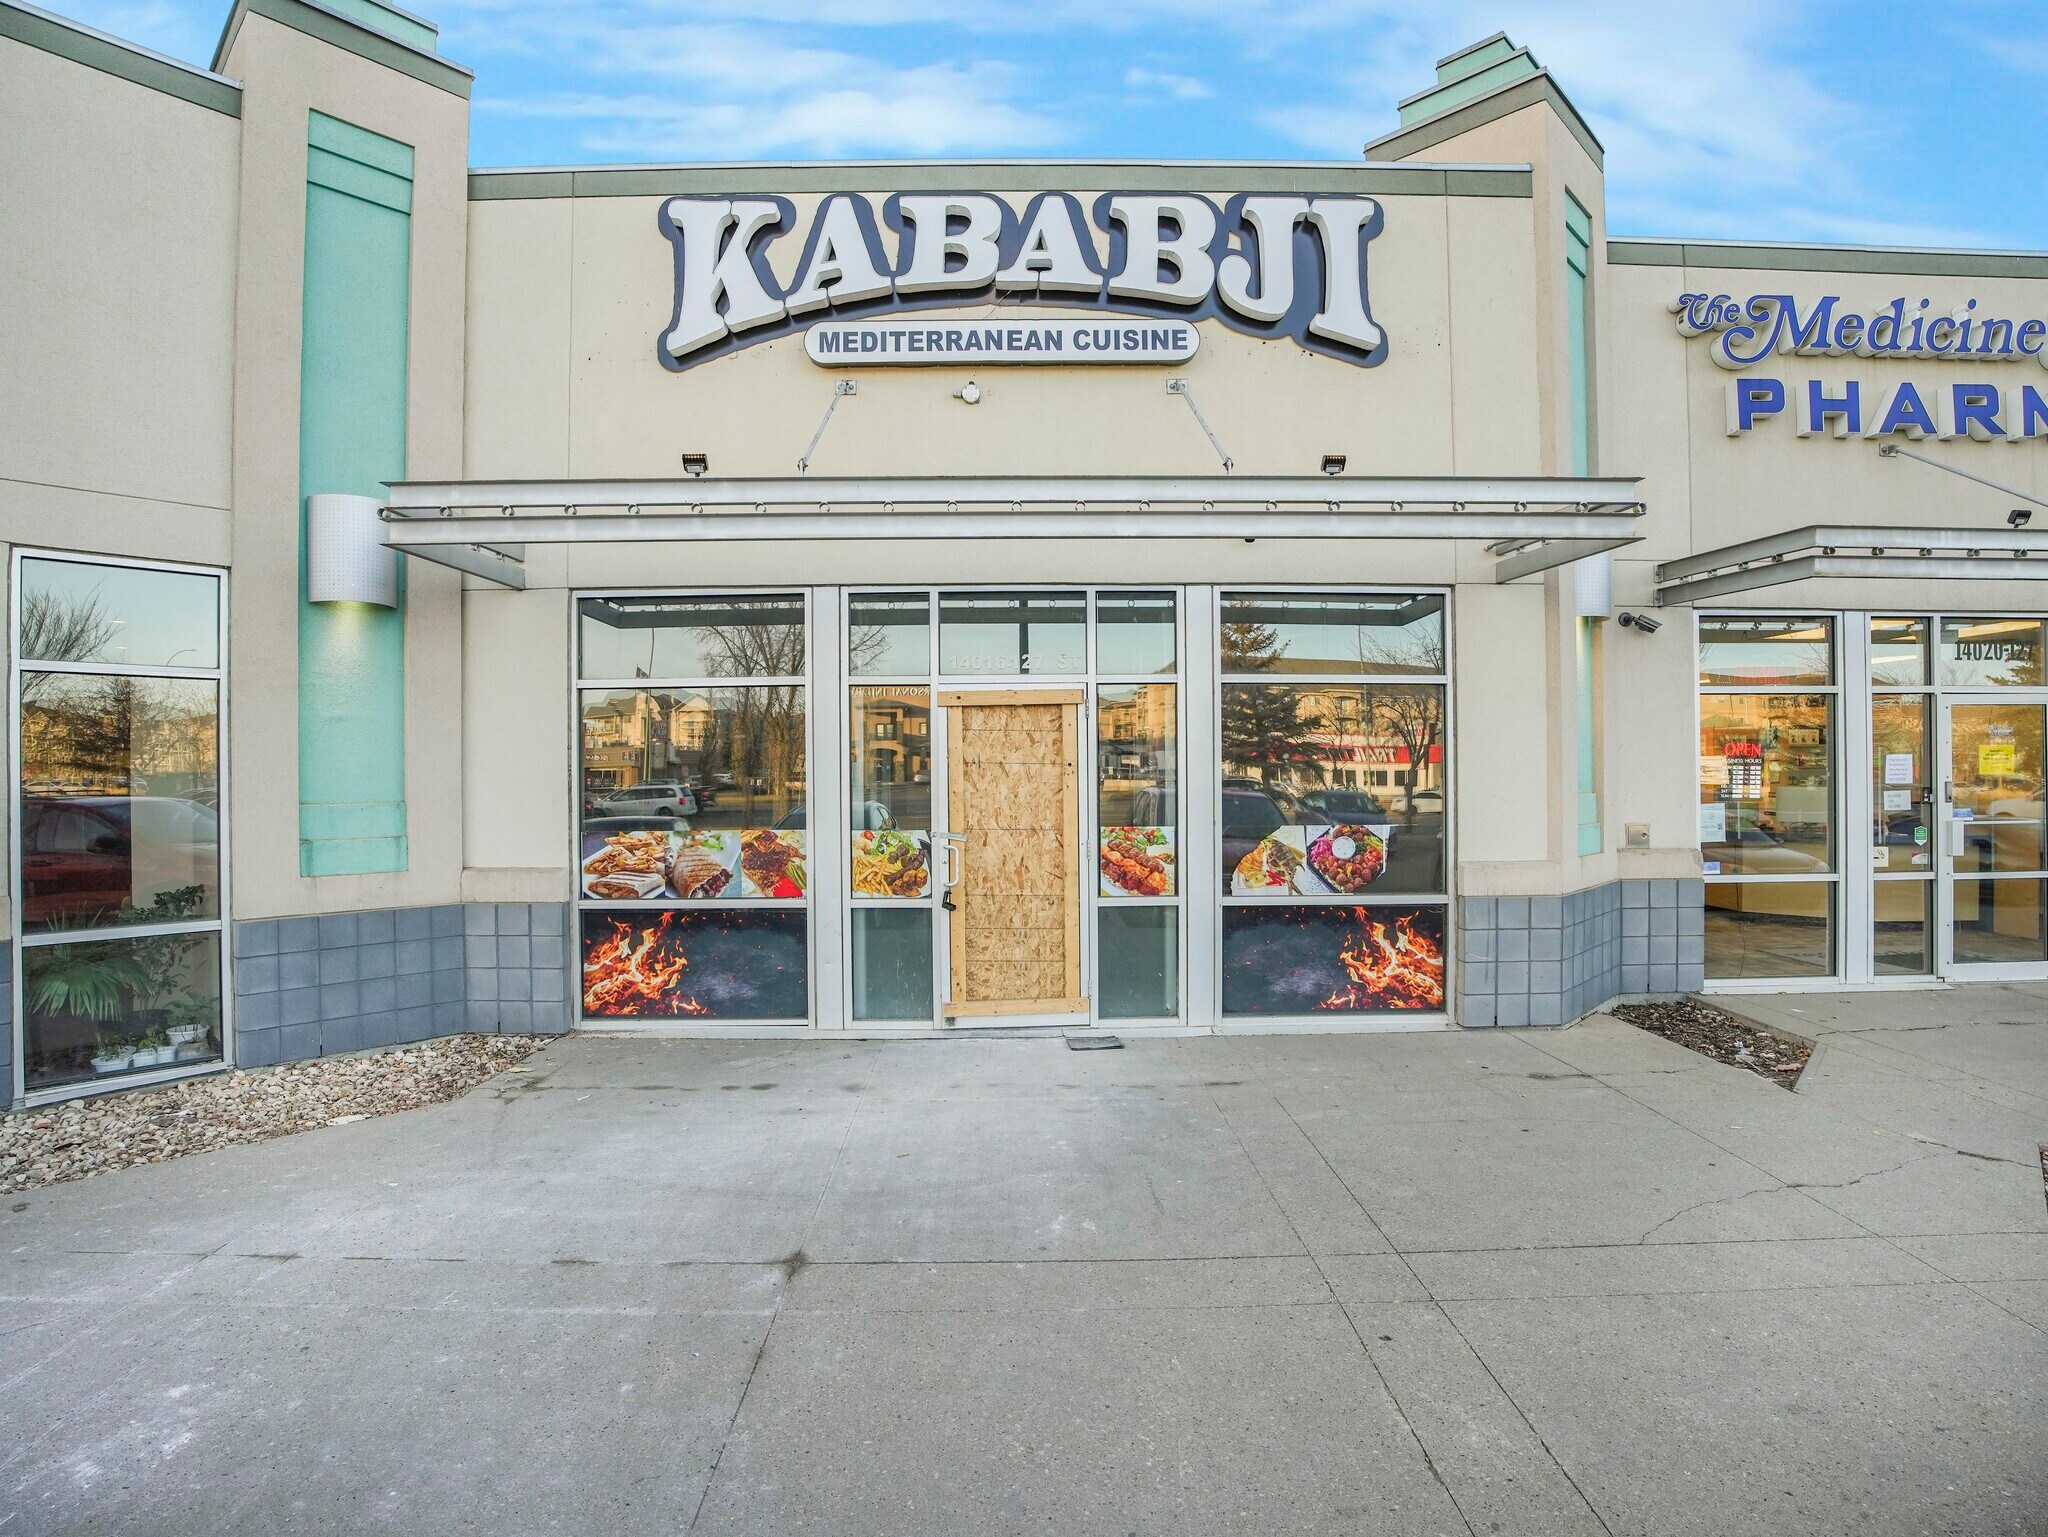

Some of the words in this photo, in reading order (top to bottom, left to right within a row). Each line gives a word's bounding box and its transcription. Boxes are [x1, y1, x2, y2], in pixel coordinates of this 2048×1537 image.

[667, 195, 1382, 357] KABABJI
[1678, 293, 1741, 331] The
[1721, 294, 2048, 365] Medicine
[818, 330, 1063, 353] MEDITERRANEAN
[1072, 329, 1188, 351] CUISINE
[1056, 654, 1081, 670] ST
[1954, 639, 2034, 662] 14020-127
[1725, 743, 1762, 756] OPEN
